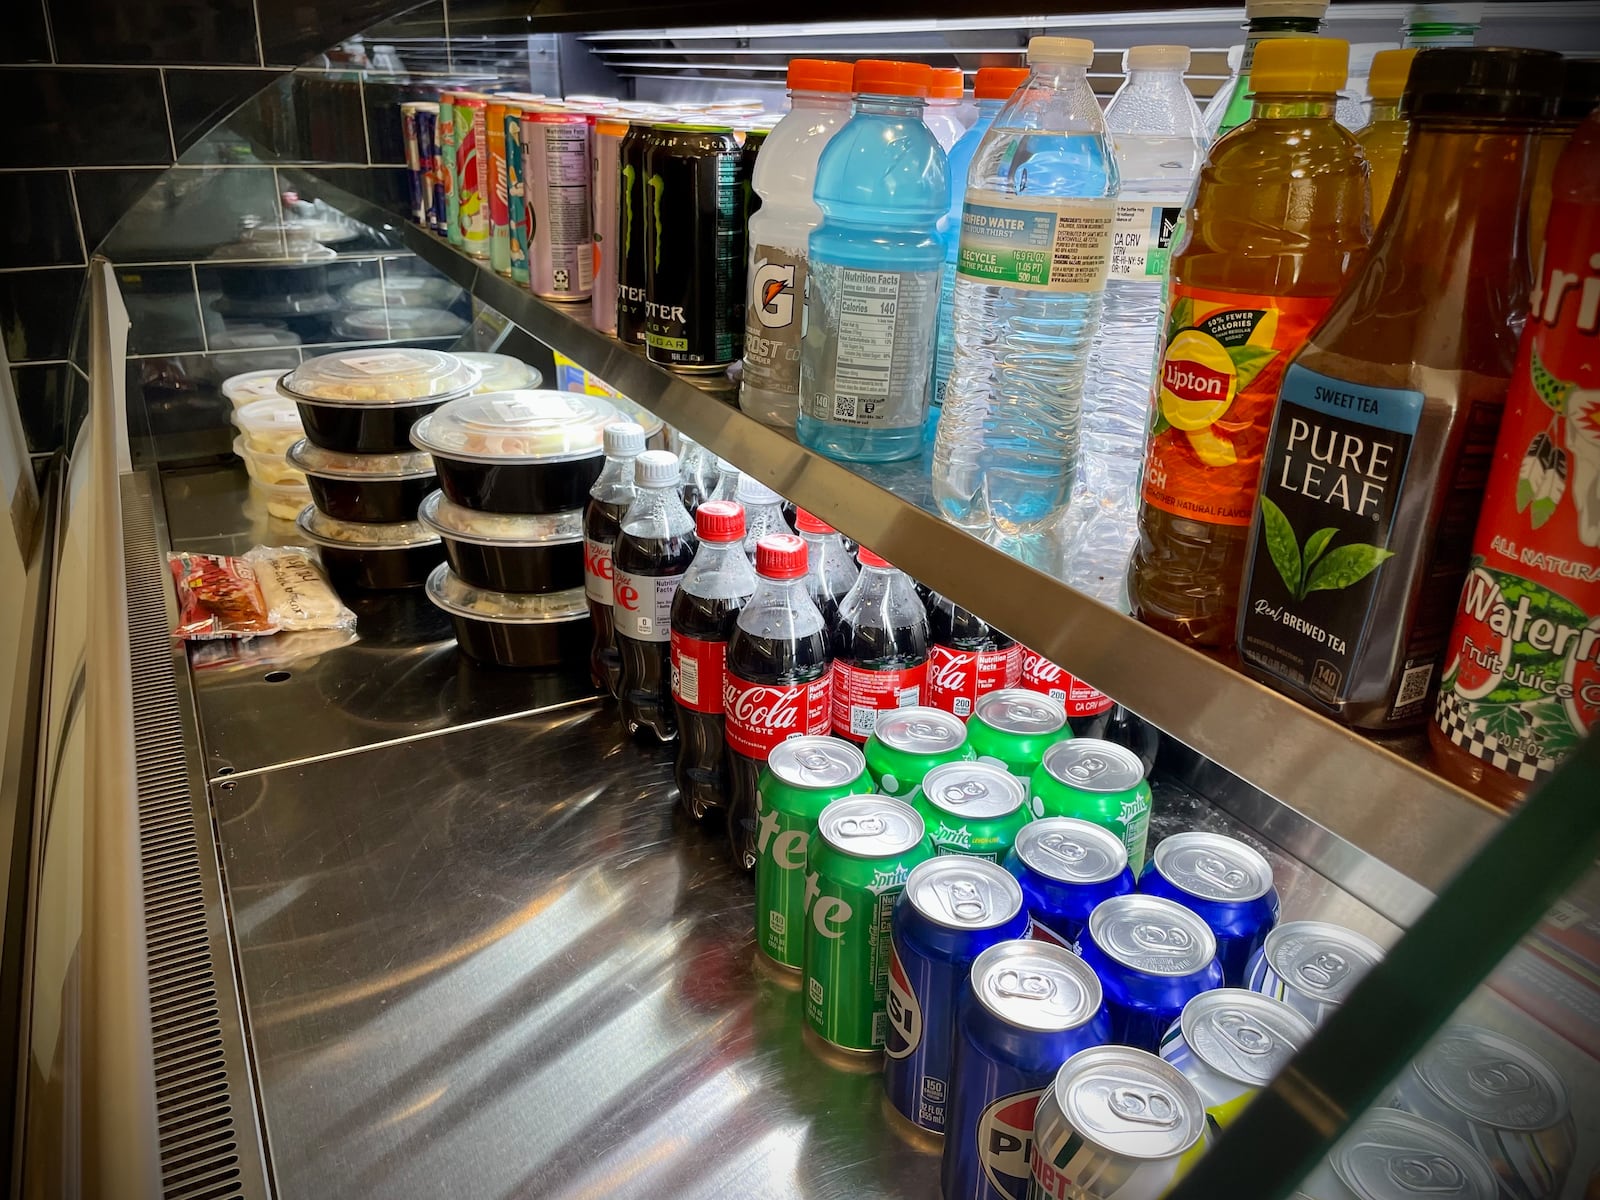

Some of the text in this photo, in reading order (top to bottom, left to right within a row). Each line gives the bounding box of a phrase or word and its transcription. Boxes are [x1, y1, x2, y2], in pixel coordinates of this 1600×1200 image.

[989, 217, 1025, 231] WATER
[986, 228, 1014, 238] THIRST
[1114, 233, 1141, 247] CA CRV
[963, 250, 996, 264] RECYCLE
[1013, 252, 1026, 261] 16.9
[1027, 252, 1035, 260] FL
[977, 264, 1003, 274] PLANET
[844, 271, 899, 286] Nutrition Facts
[1018, 272, 1030, 282] 500
[842, 301, 896, 315] Calories 140
[1225, 312, 1254, 321] FEWER
[1211, 320, 1252, 334] CALORIES
[1166, 365, 1222, 395] Lipton
[1314, 386, 1380, 415] SWEET TEA
[1286, 418, 1394, 482] PURE
[1280, 455, 1384, 516] LEAF
[1176, 500, 1216, 516] NATURAL
[592, 543, 610, 556] Diet
[1490, 535, 1519, 560] ALL
[1255, 599, 1284, 621] Real
[1283, 612, 1327, 643] BREWED
[1327, 634, 1347, 656] TEA
[979, 654, 1007, 663] Nutrition
[1462, 635, 1574, 699] Fruit Juice
[1319, 666, 1337, 687] 140
[1051, 690, 1065, 700] 200
[955, 699, 970, 707] 200
[1075, 702, 1085, 711] CA
[1085, 702, 1099, 711] CRV
[745, 724, 774, 736] TASTE
[1498, 731, 1513, 747] 20
[934, 822, 970, 846] Sprite
[771, 913, 784, 925] 140
[810, 979, 822, 995] 140
[926, 1079, 942, 1093] 150
